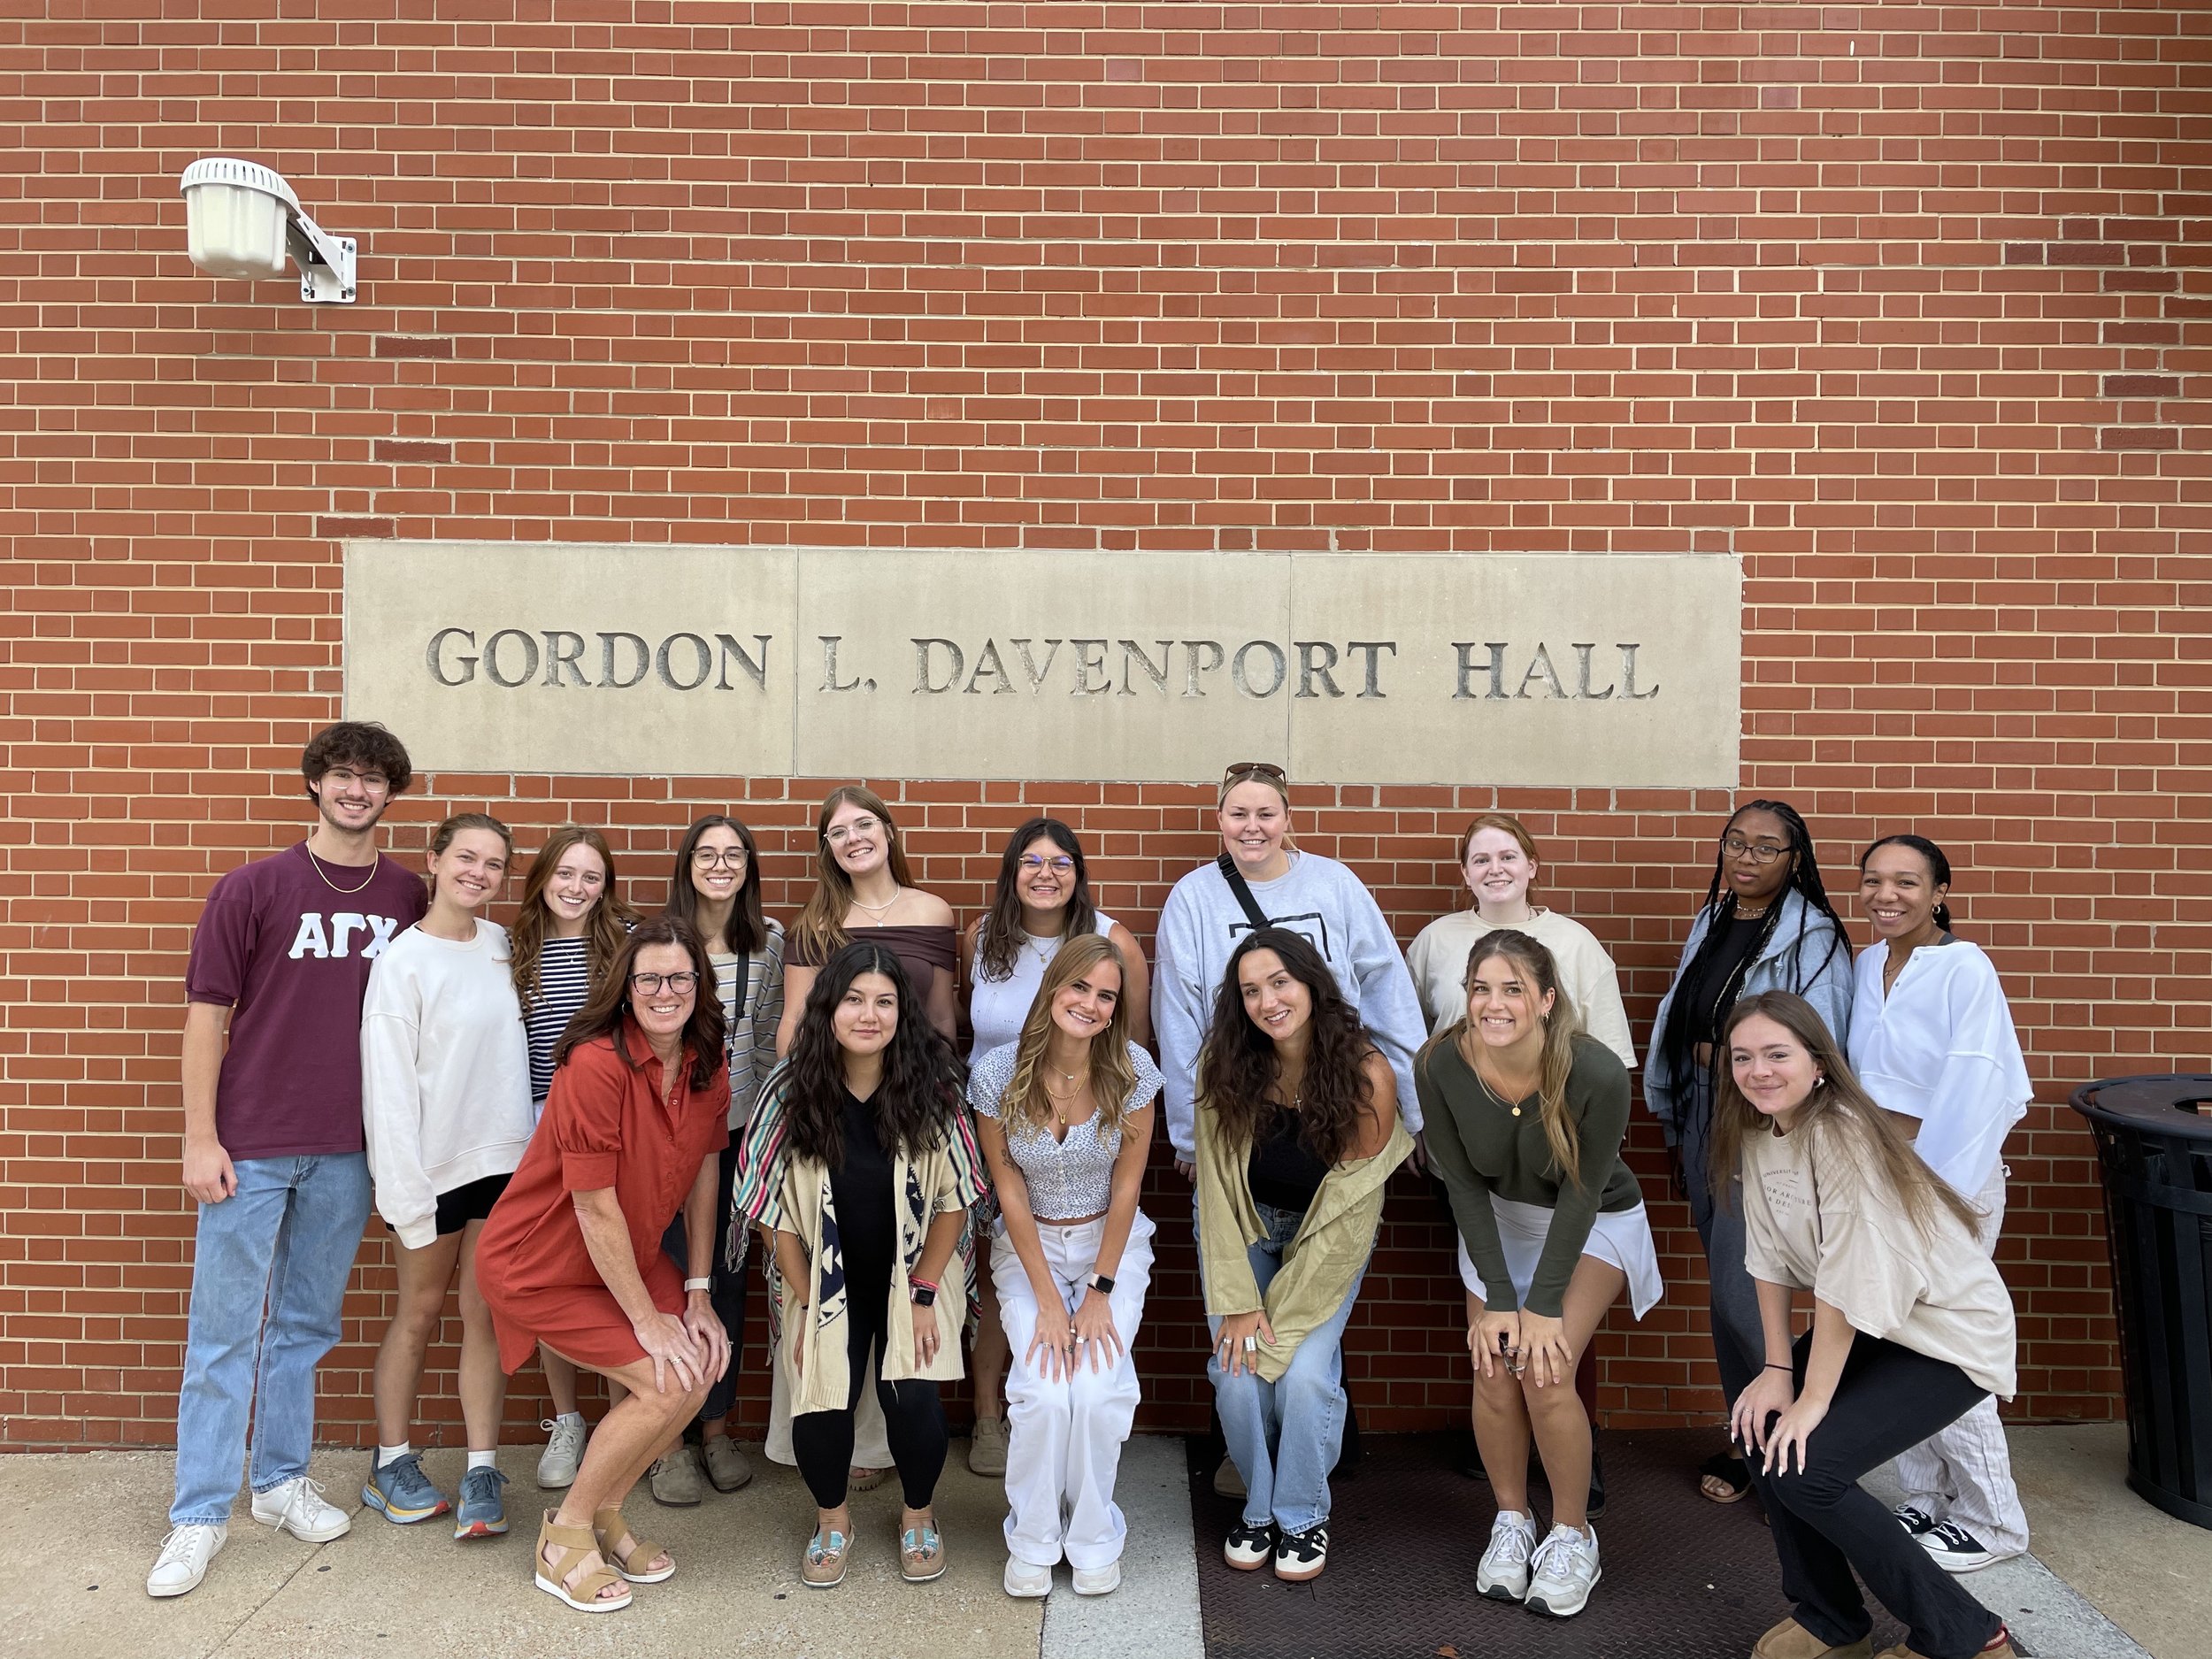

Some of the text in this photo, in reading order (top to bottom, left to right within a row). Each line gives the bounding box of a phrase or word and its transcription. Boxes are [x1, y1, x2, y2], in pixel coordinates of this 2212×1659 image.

[426, 627, 1660, 700] GORDON L. DAVENPORT HALL
